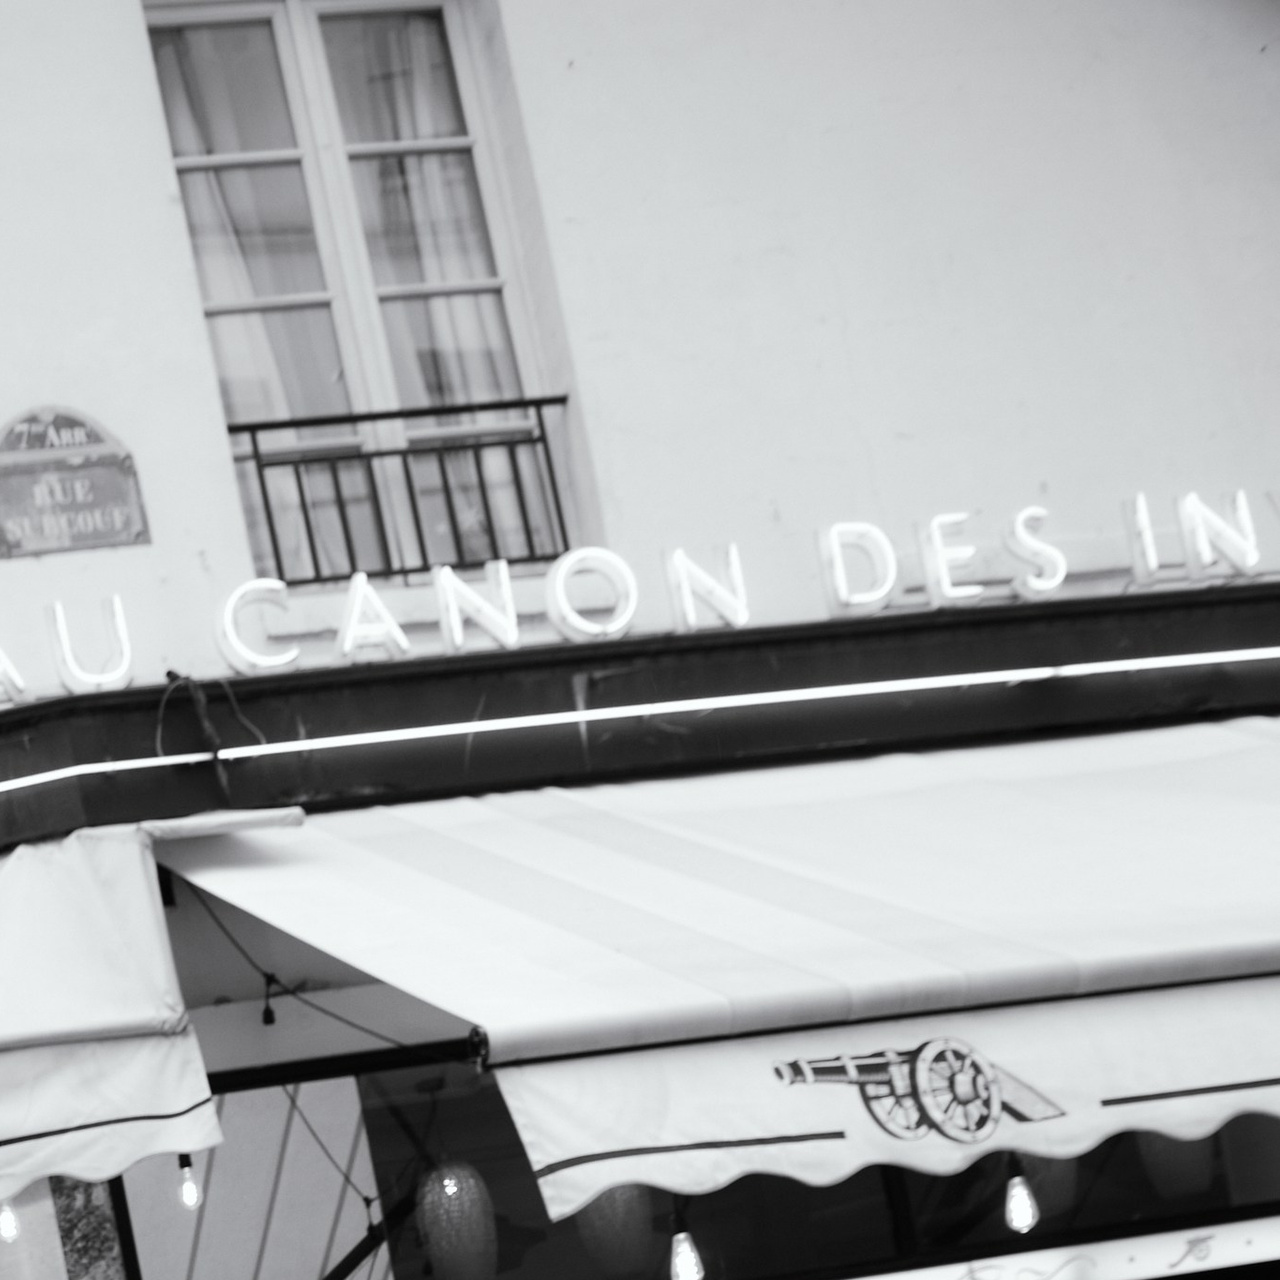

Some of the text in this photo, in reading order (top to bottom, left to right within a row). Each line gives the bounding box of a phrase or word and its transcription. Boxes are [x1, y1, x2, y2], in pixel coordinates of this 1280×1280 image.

[32, 472, 96, 508] RUE
[222, 541, 749, 669] CANON
[827, 506, 1067, 606] DES
[1135, 488, 1280, 570] IN
